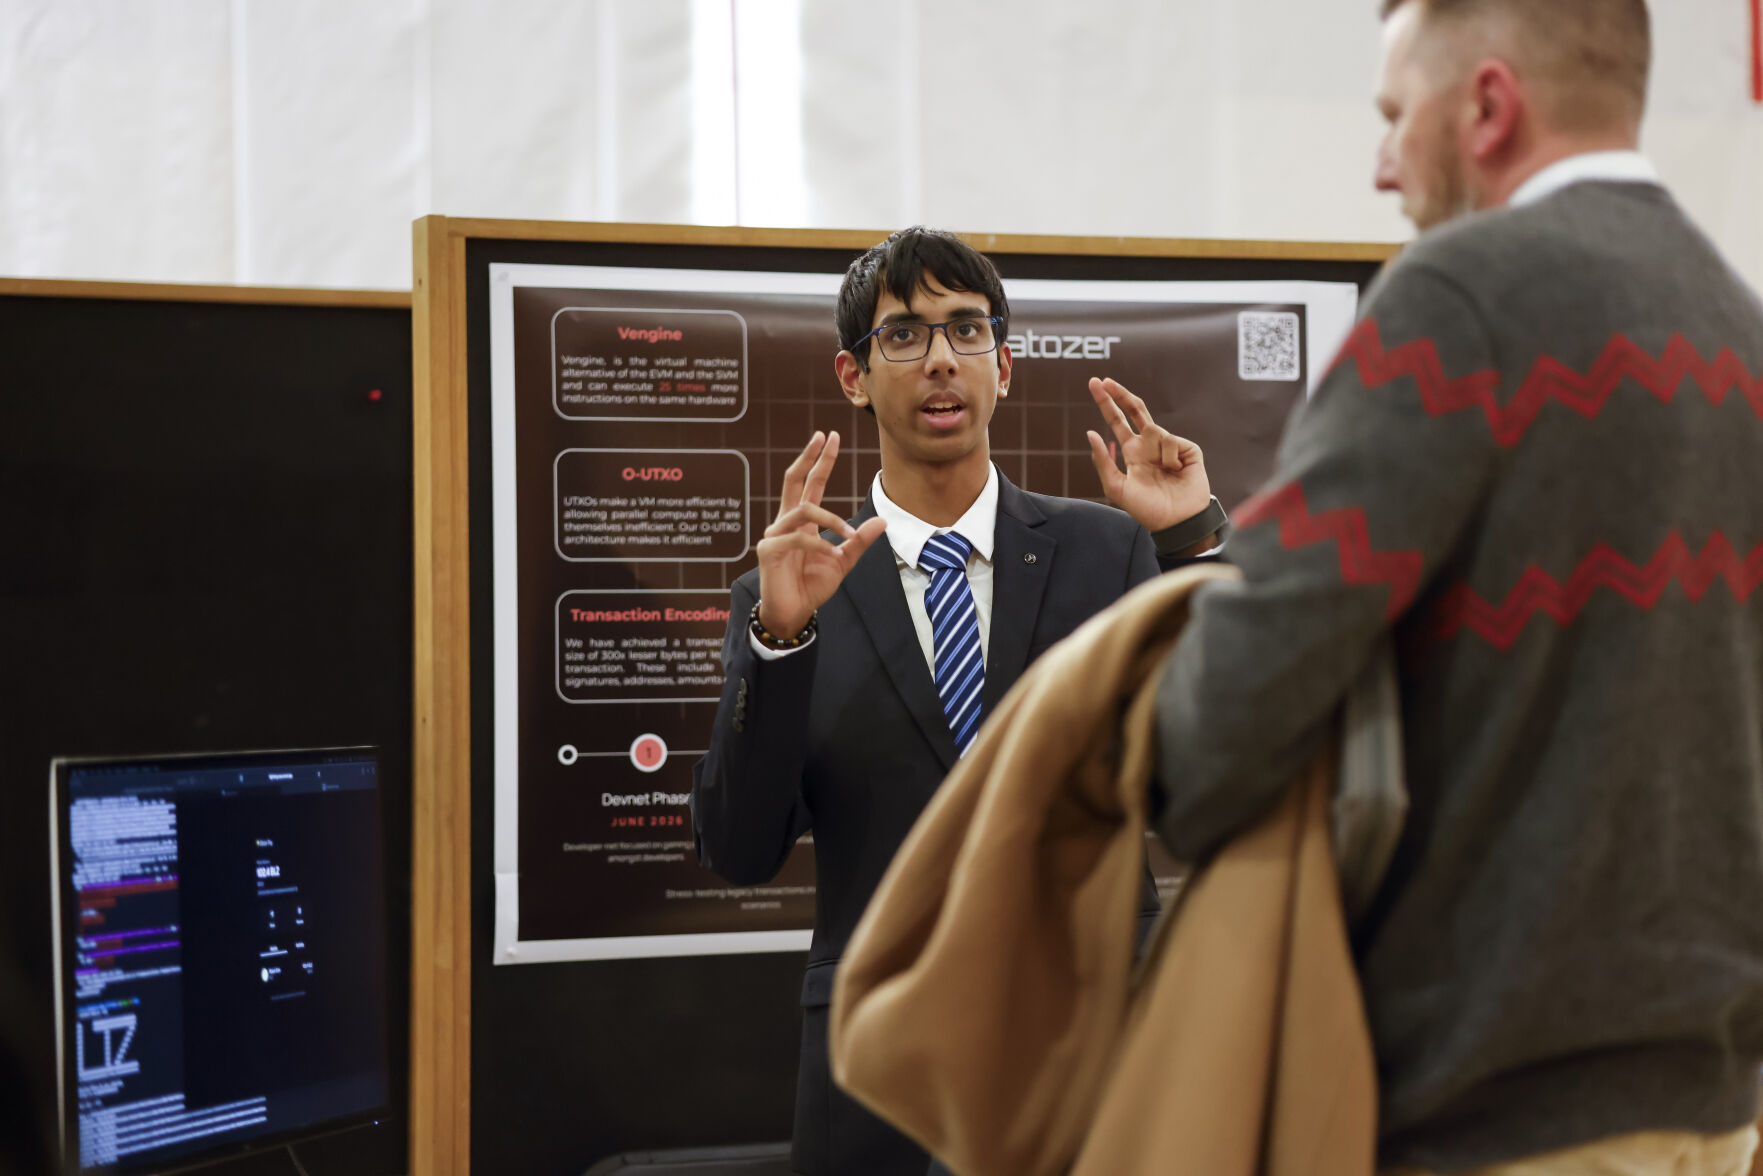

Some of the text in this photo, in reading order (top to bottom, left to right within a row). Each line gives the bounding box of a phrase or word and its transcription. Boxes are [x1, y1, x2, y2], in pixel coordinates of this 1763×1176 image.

[617, 326, 683, 343] Vengine
[1007, 328, 1121, 359] atozer
[613, 356, 623, 366] is
[629, 356, 648, 366] the
[654, 357, 687, 367] virtual
[693, 357, 739, 367] machine
[561, 368, 739, 380] alternative of the EVM and the SVM
[561, 381, 739, 392] and can execute 25 times more
[562, 393, 737, 405] instructions on the same hardware
[622, 467, 684, 481] O-UTXO
[563, 496, 598, 507] UTXOs
[600, 497, 629, 506] make
[639, 497, 656, 506] VM
[657, 498, 684, 507] more
[685, 497, 726, 507] efficient
[728, 497, 741, 508] by
[564, 509, 741, 521] allowing parallel compute but are
[564, 522, 623, 532] themselves
[678, 522, 698, 532] Our
[700, 522, 741, 532] O-UTXO
[564, 535, 712, 545] architecture makes it efficient
[570, 607, 661, 622] Transaction
[565, 638, 583, 648] We
[589, 638, 615, 648] have
[621, 637, 667, 648] achieved
[673, 639, 680, 647] a
[565, 651, 585, 661] size
[587, 651, 599, 661] of
[629, 650, 658, 660] lesser
[660, 650, 688, 662] bytes
[690, 651, 707, 662] per
[636, 662, 667, 673] These
[676, 662, 715, 672] include
[601, 791, 650, 807] Devnet
[611, 815, 684, 827] JUNE 2026
